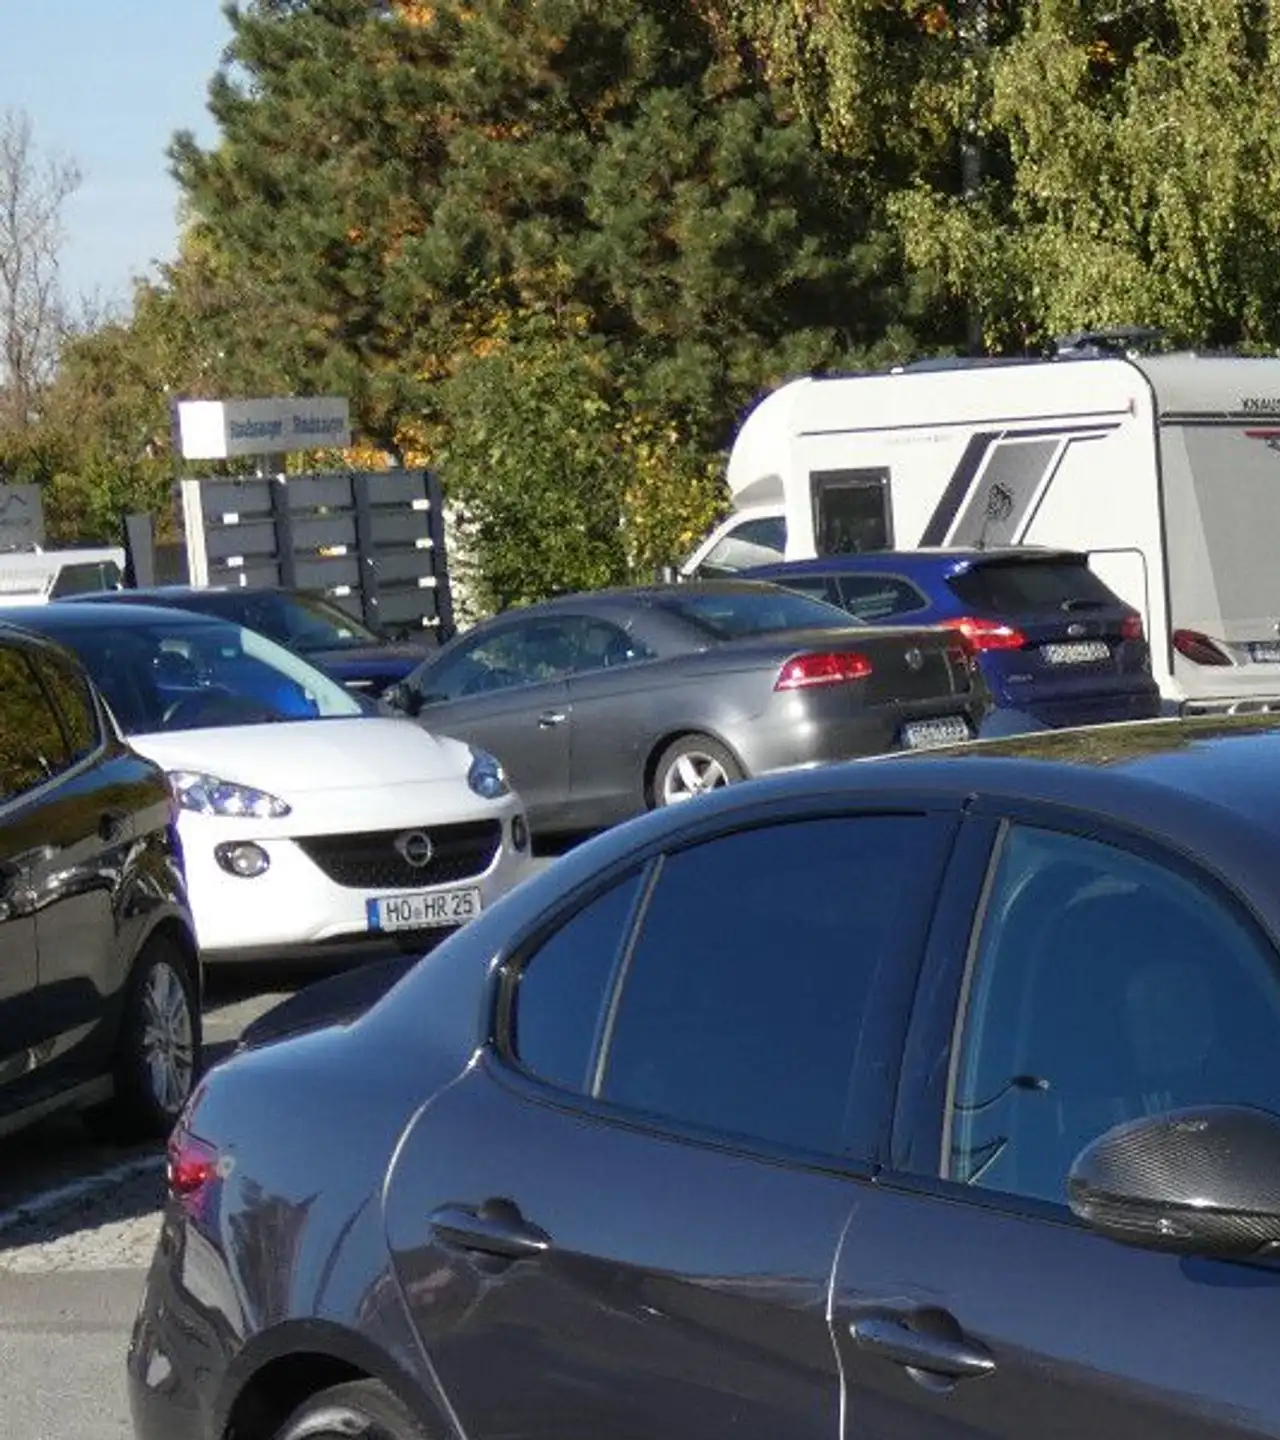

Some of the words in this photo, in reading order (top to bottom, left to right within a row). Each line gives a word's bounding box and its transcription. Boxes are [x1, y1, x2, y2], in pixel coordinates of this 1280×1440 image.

[386, 900, 412, 922] HO
[424, 896, 449, 919] HR
[450, 892, 474, 916] 25
